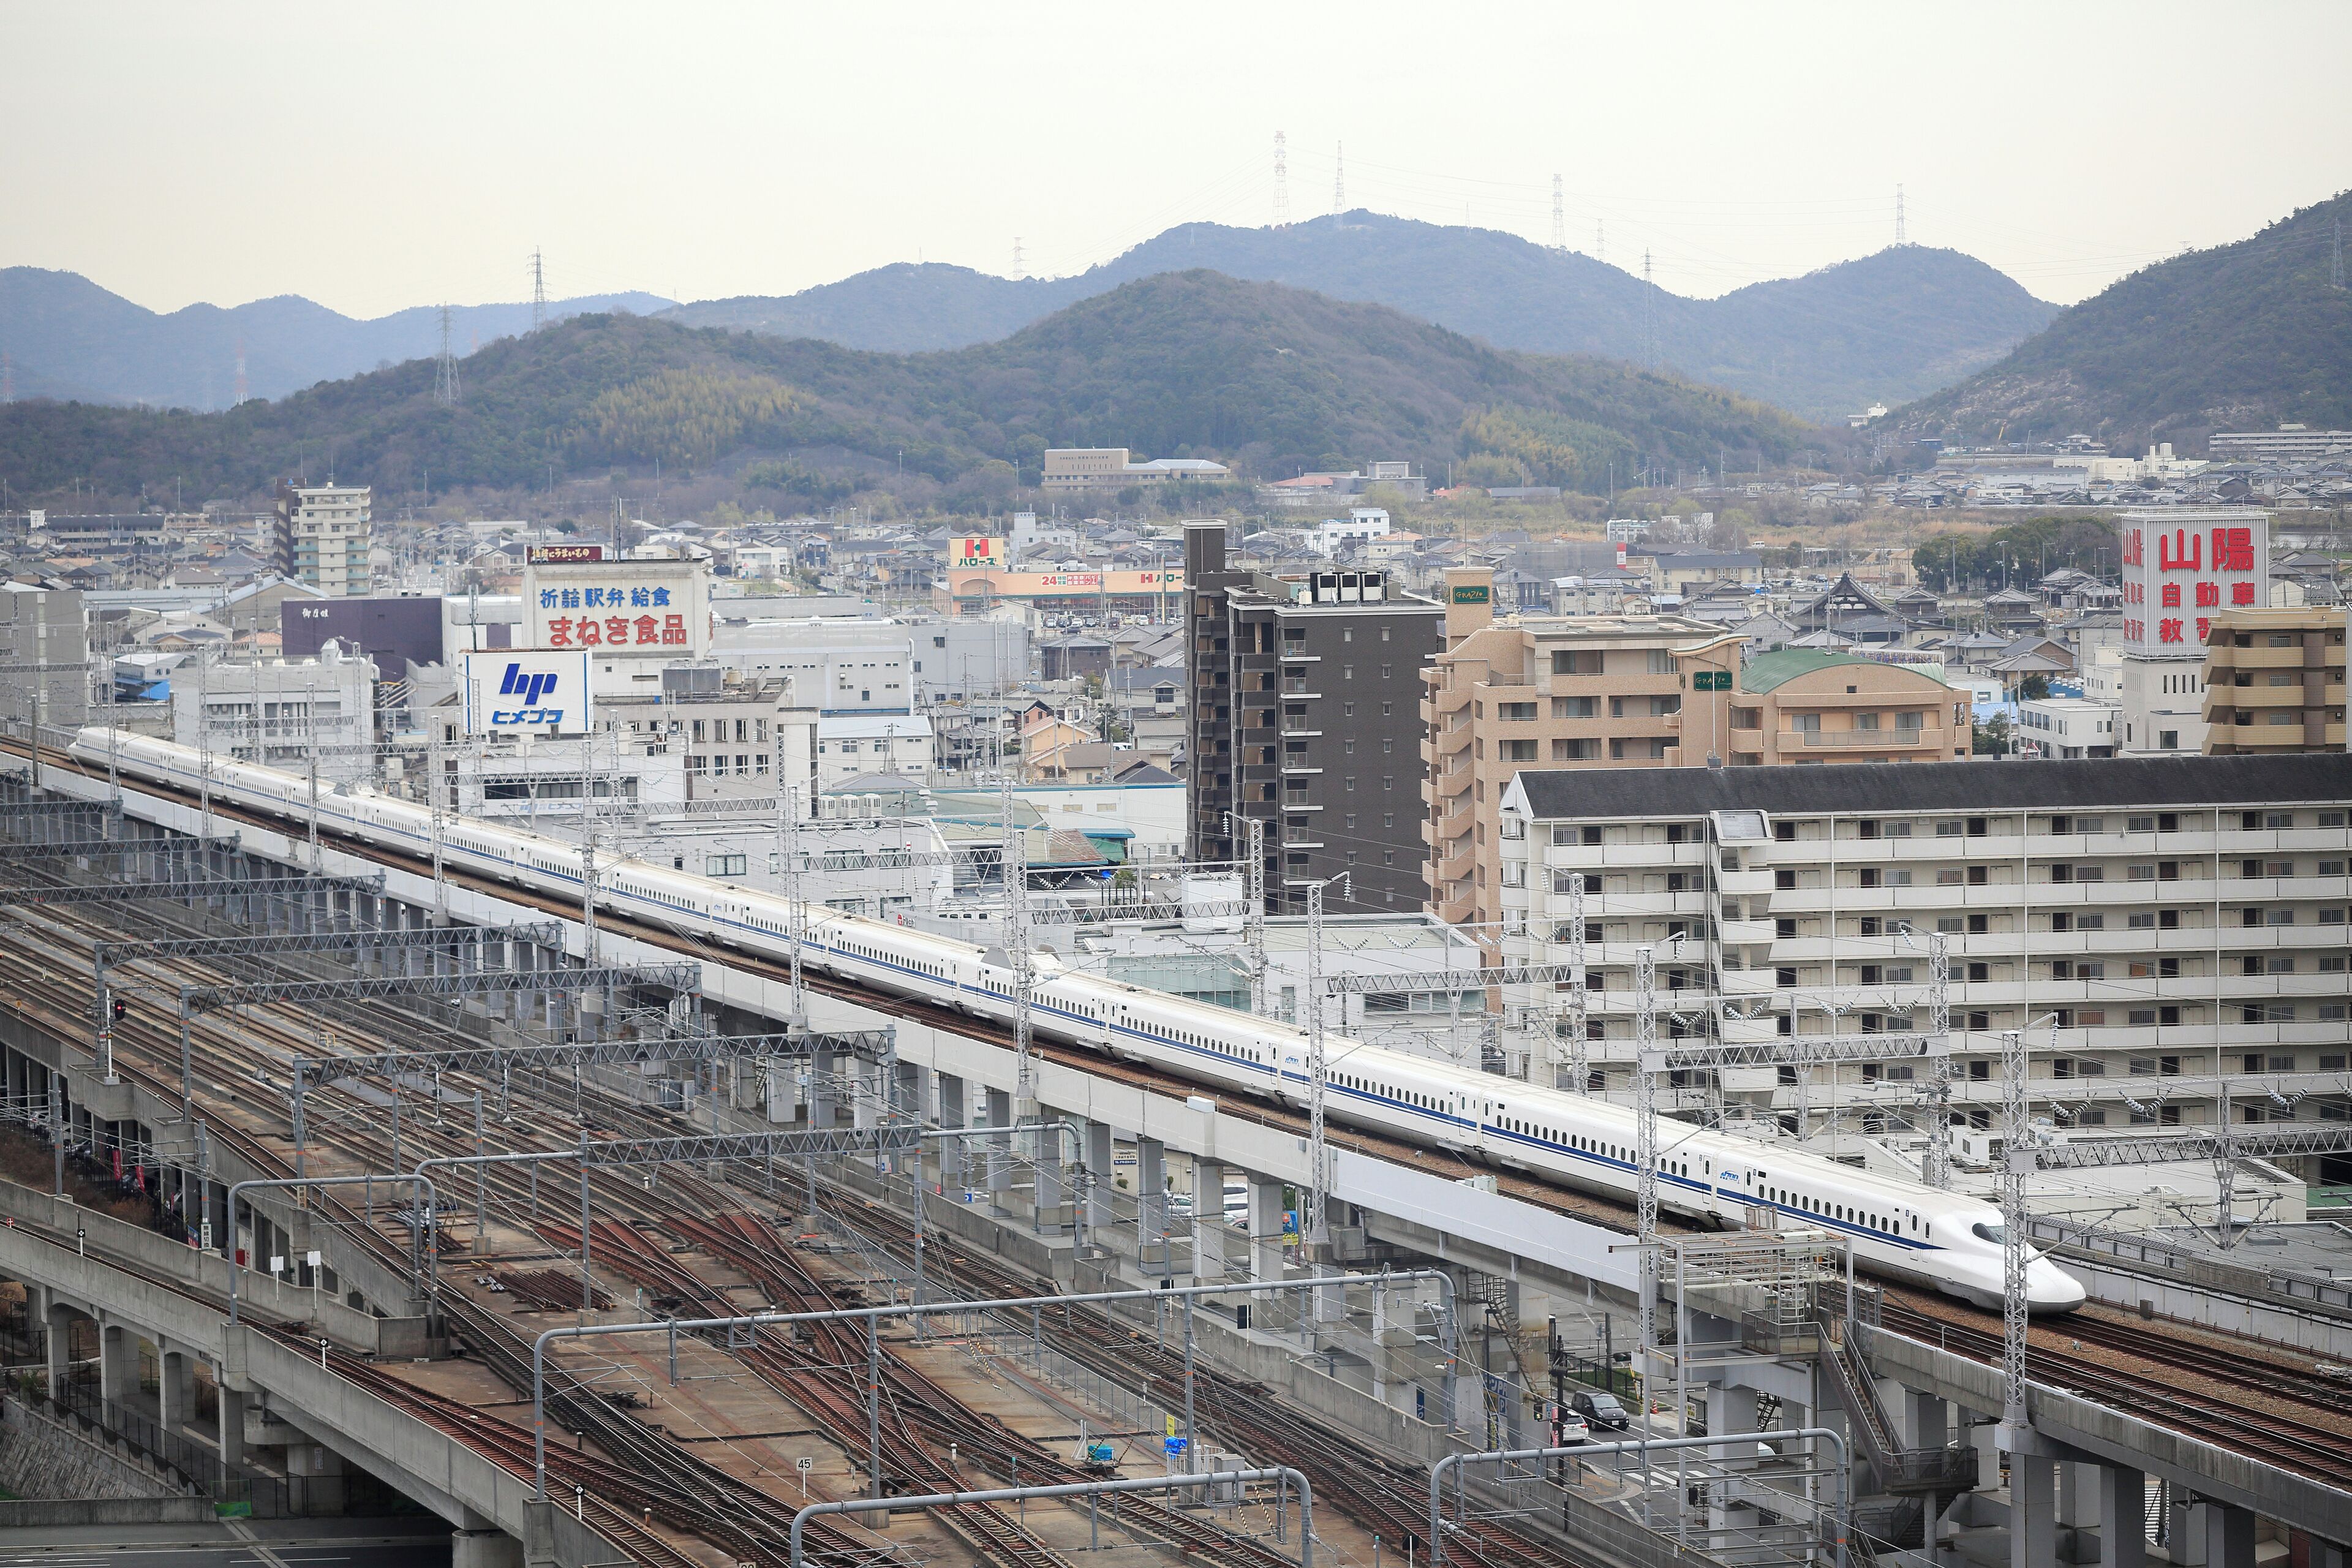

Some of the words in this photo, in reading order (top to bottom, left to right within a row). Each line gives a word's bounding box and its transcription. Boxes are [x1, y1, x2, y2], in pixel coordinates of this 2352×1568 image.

[2160, 528, 2255, 572] 山陽
[959, 557, 997, 566] ハローズ
[1042, 576, 1057, 586] 24
[2162, 581, 2255, 608] 自動車
[549, 614, 687, 646] まねき食品
[1696, 676, 1725, 685] GRAIO
[492, 707, 564, 725] ヒメプラ
[798, 1459, 811, 1469] 45
